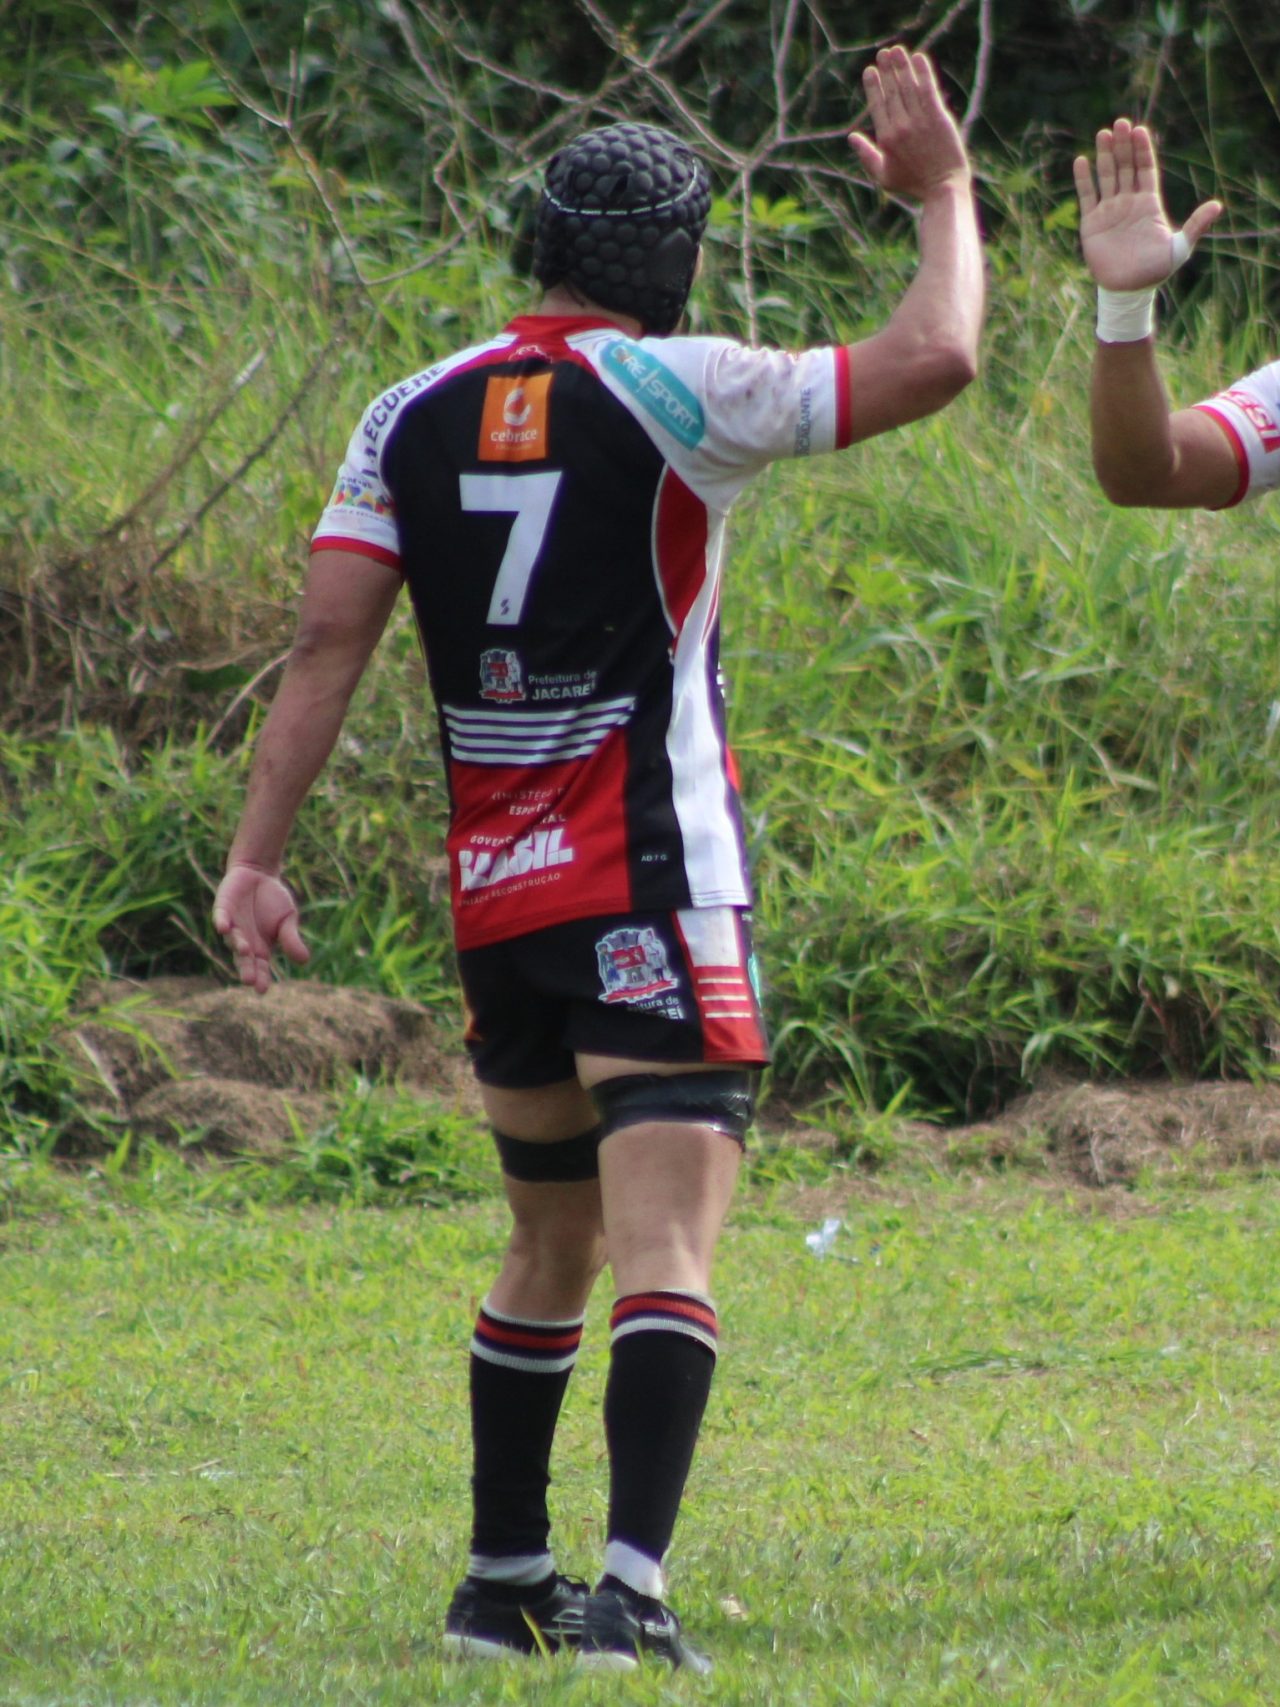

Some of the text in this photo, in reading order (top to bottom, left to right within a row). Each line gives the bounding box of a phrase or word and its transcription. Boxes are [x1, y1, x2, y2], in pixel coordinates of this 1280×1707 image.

[648, 379, 699, 430] SPORT
[490, 428, 538, 442] cebrace
[459, 469, 564, 626] 7
[528, 670, 597, 685] Prefeitura de
[665, 996, 680, 1006] de
